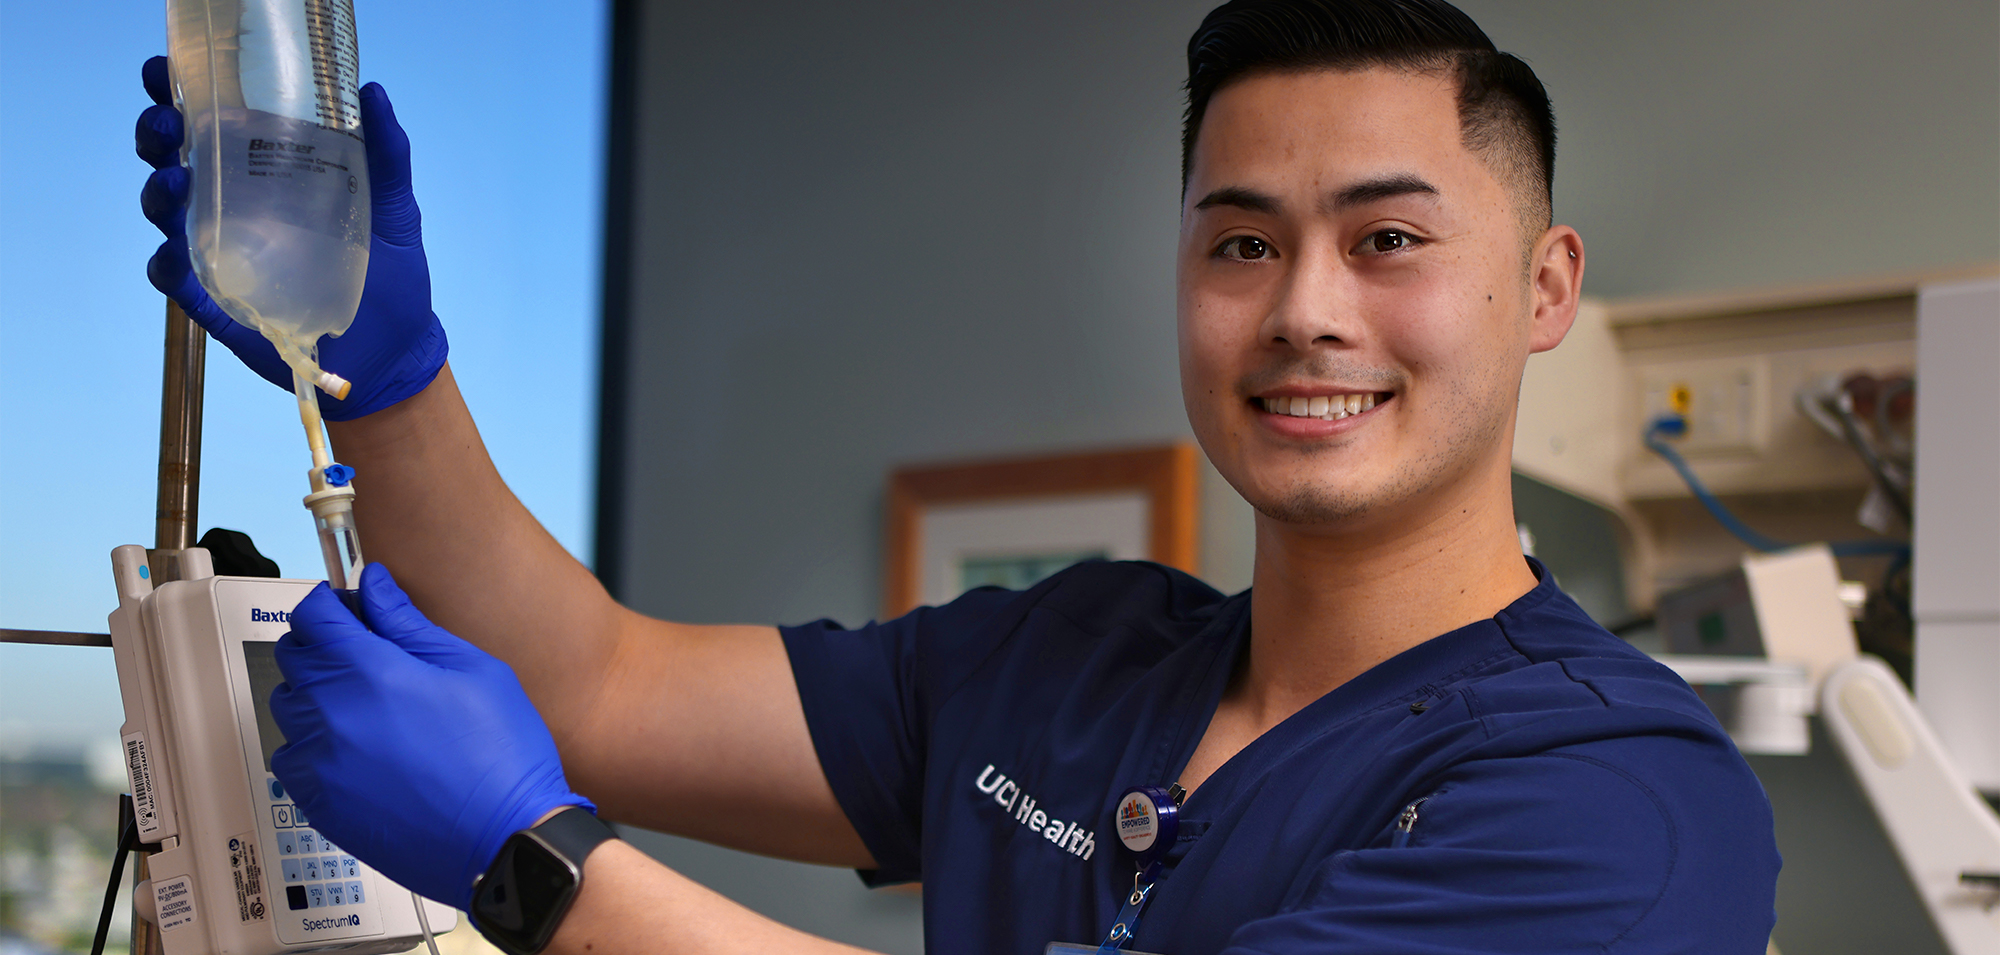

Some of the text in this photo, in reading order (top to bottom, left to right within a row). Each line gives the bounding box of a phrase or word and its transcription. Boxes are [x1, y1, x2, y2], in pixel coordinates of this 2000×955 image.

[248, 138, 316, 155] Baxter
[251, 608, 292, 623] Baxte
[975, 763, 1096, 861] UCI Health
[1121, 816, 1150, 829] EMPOWERED
[301, 834, 313, 842] ABC
[286, 842, 331, 853] 0 1 2
[307, 858, 357, 870] JKL MNO PQR
[311, 867, 355, 878] 4 5 6
[168, 881, 185, 891] POWER
[310, 885, 360, 896] STU VWX YZ
[162, 899, 187, 911] ACCESSORY
[316, 894, 360, 906] 7 8 9
[160, 905, 192, 920] CONNECTIONS
